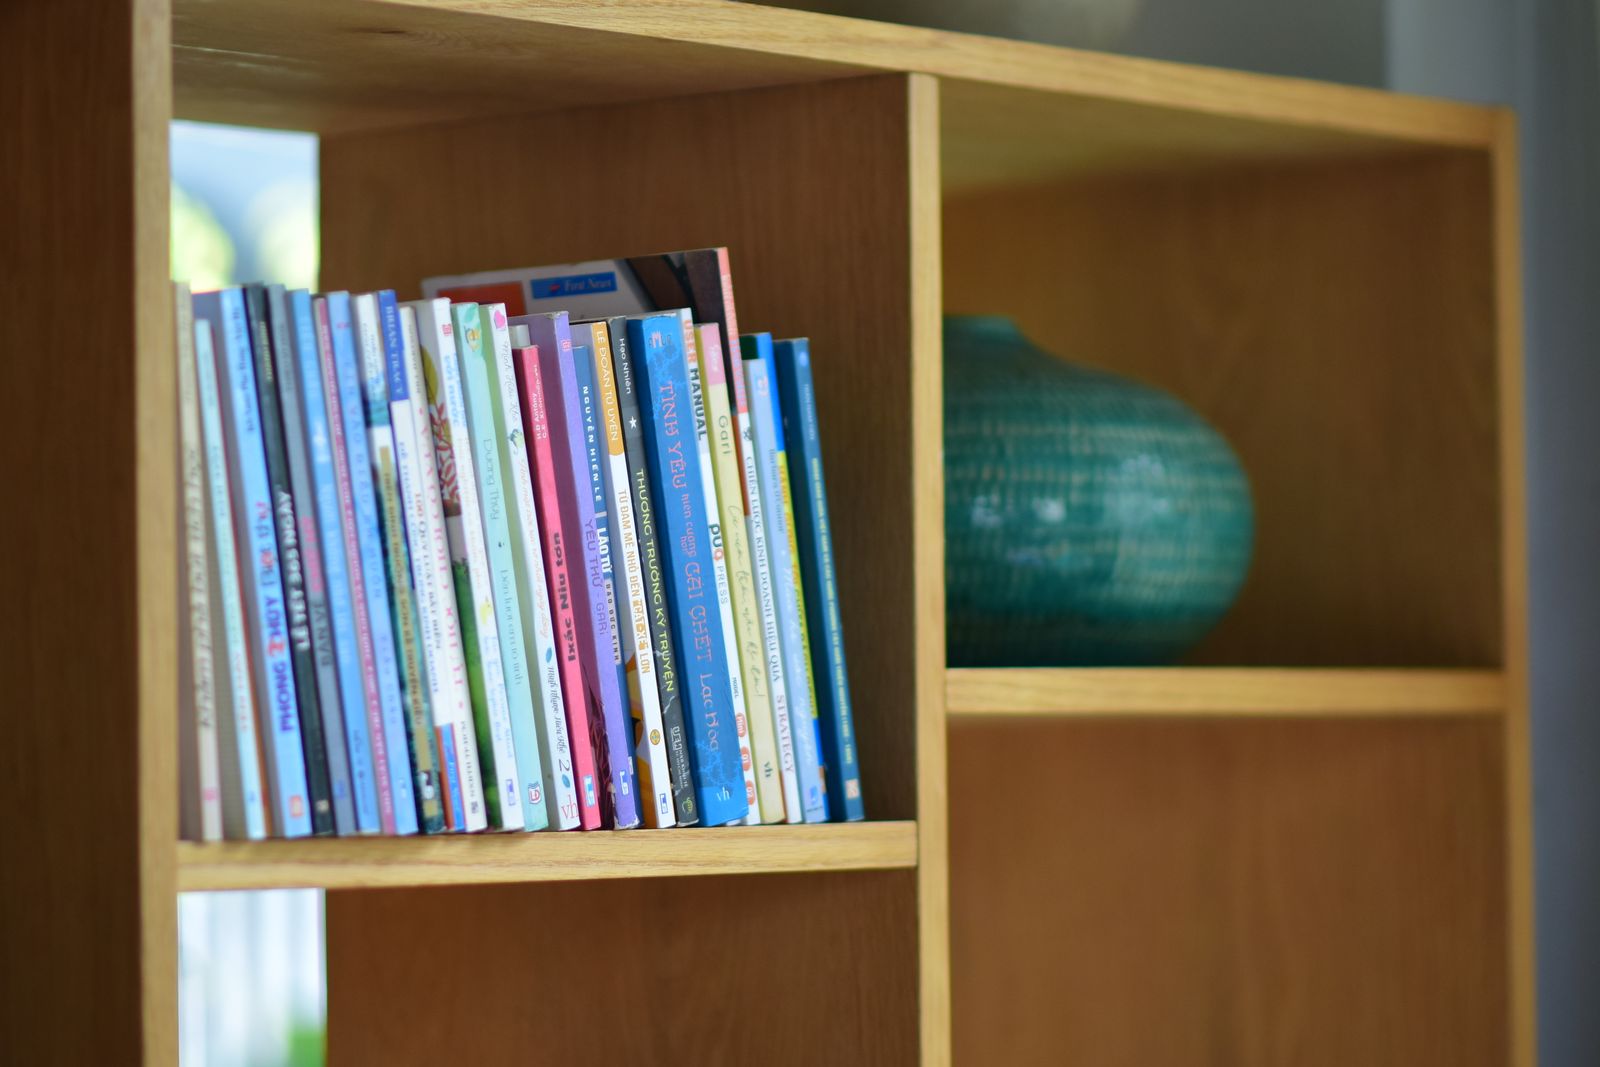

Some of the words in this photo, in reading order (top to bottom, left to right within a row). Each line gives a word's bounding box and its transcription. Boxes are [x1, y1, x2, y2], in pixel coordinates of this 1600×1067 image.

[384, 305, 398, 347] BRIAN
[617, 338, 627, 360] Hạo
[390, 351, 404, 395] TRACY
[621, 361, 632, 394] Nhiên
[683, 319, 696, 363] USER
[690, 367, 706, 440] MANUAL
[658, 379, 682, 436] TÌNH
[581, 385, 594, 442] NGUYỄN
[594, 487, 601, 501] LÊ
[717, 414, 731, 454] Gari
[482, 438, 497, 485] Dương
[667, 440, 688, 489] YÊU
[414, 492, 424, 517] 100
[619, 505, 630, 530] ĐAM
[584, 519, 597, 551] YÊU
[623, 531, 634, 548] MÊ
[755, 536, 766, 567] KINH
[625, 550, 637, 573] NHỎ
[556, 573, 568, 609] Niu
[629, 575, 641, 596] ĐẾN
[716, 565, 728, 604] PRESS
[759, 571, 773, 617] DOANH
[639, 652, 650, 673] LỚN
[657, 630, 674, 692] TRUYỆN
[272, 660, 294, 731] PHONG
[775, 695, 794, 773] STRATEGY
[558, 757, 570, 772] 2
[715, 787, 731, 802] vh
